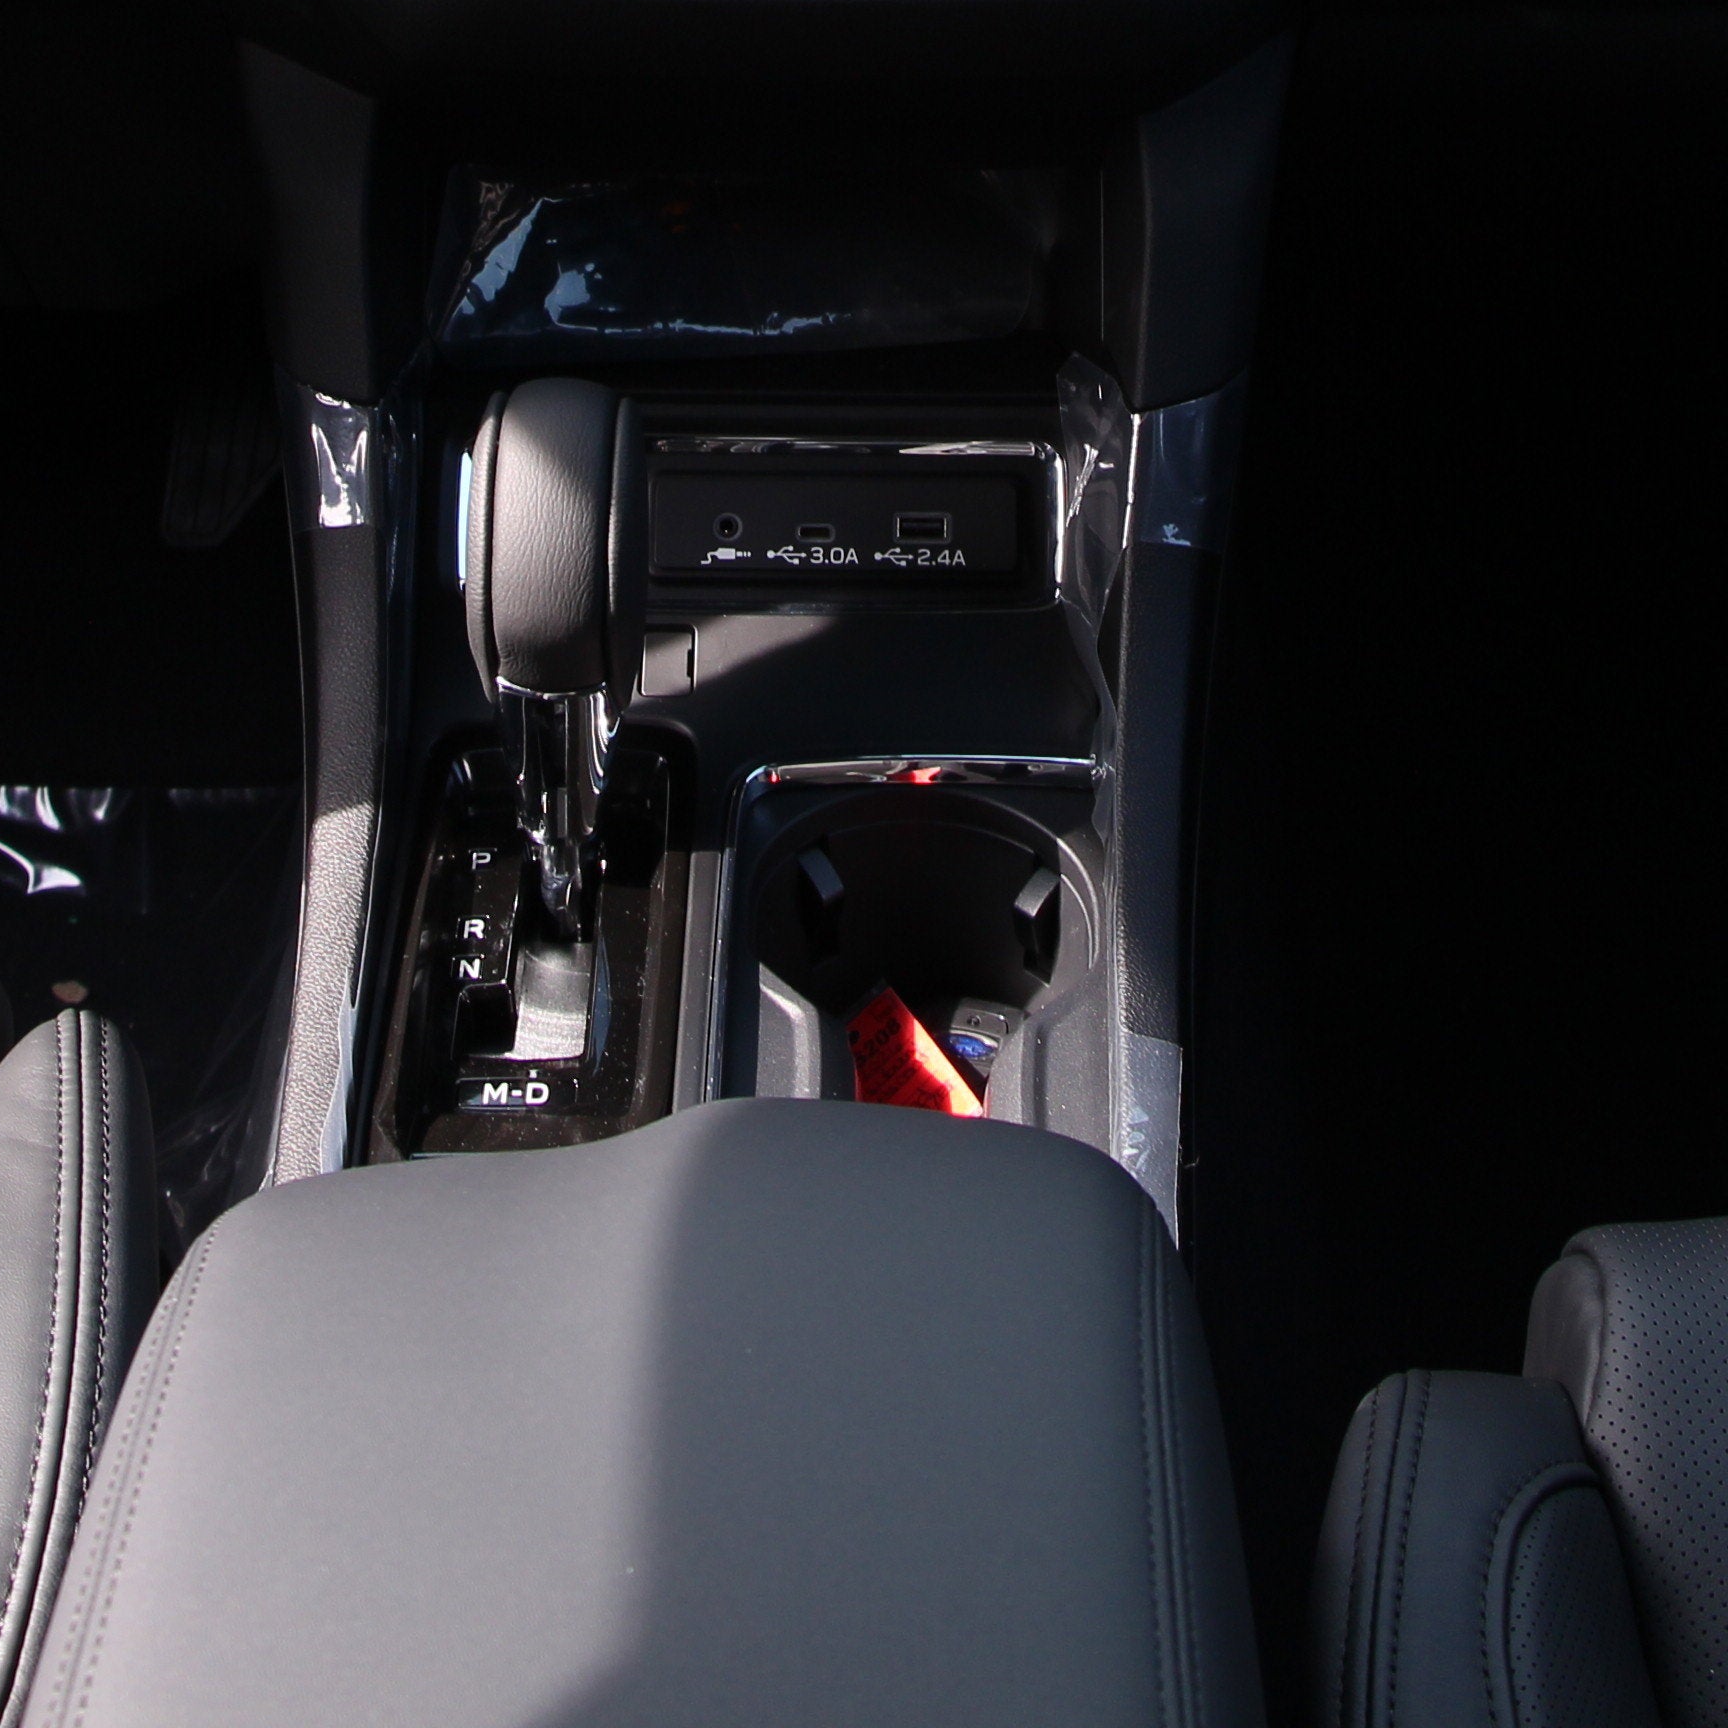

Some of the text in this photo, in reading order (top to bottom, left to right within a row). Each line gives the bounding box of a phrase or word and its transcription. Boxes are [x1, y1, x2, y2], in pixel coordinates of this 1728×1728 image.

[809, 547, 859, 566] 3.0A
[917, 548, 966, 567] 2.4A
[471, 851, 492, 871] P
[462, 918, 486, 940] R
[458, 958, 481, 980] N
[481, 1081, 551, 1107] M-D
